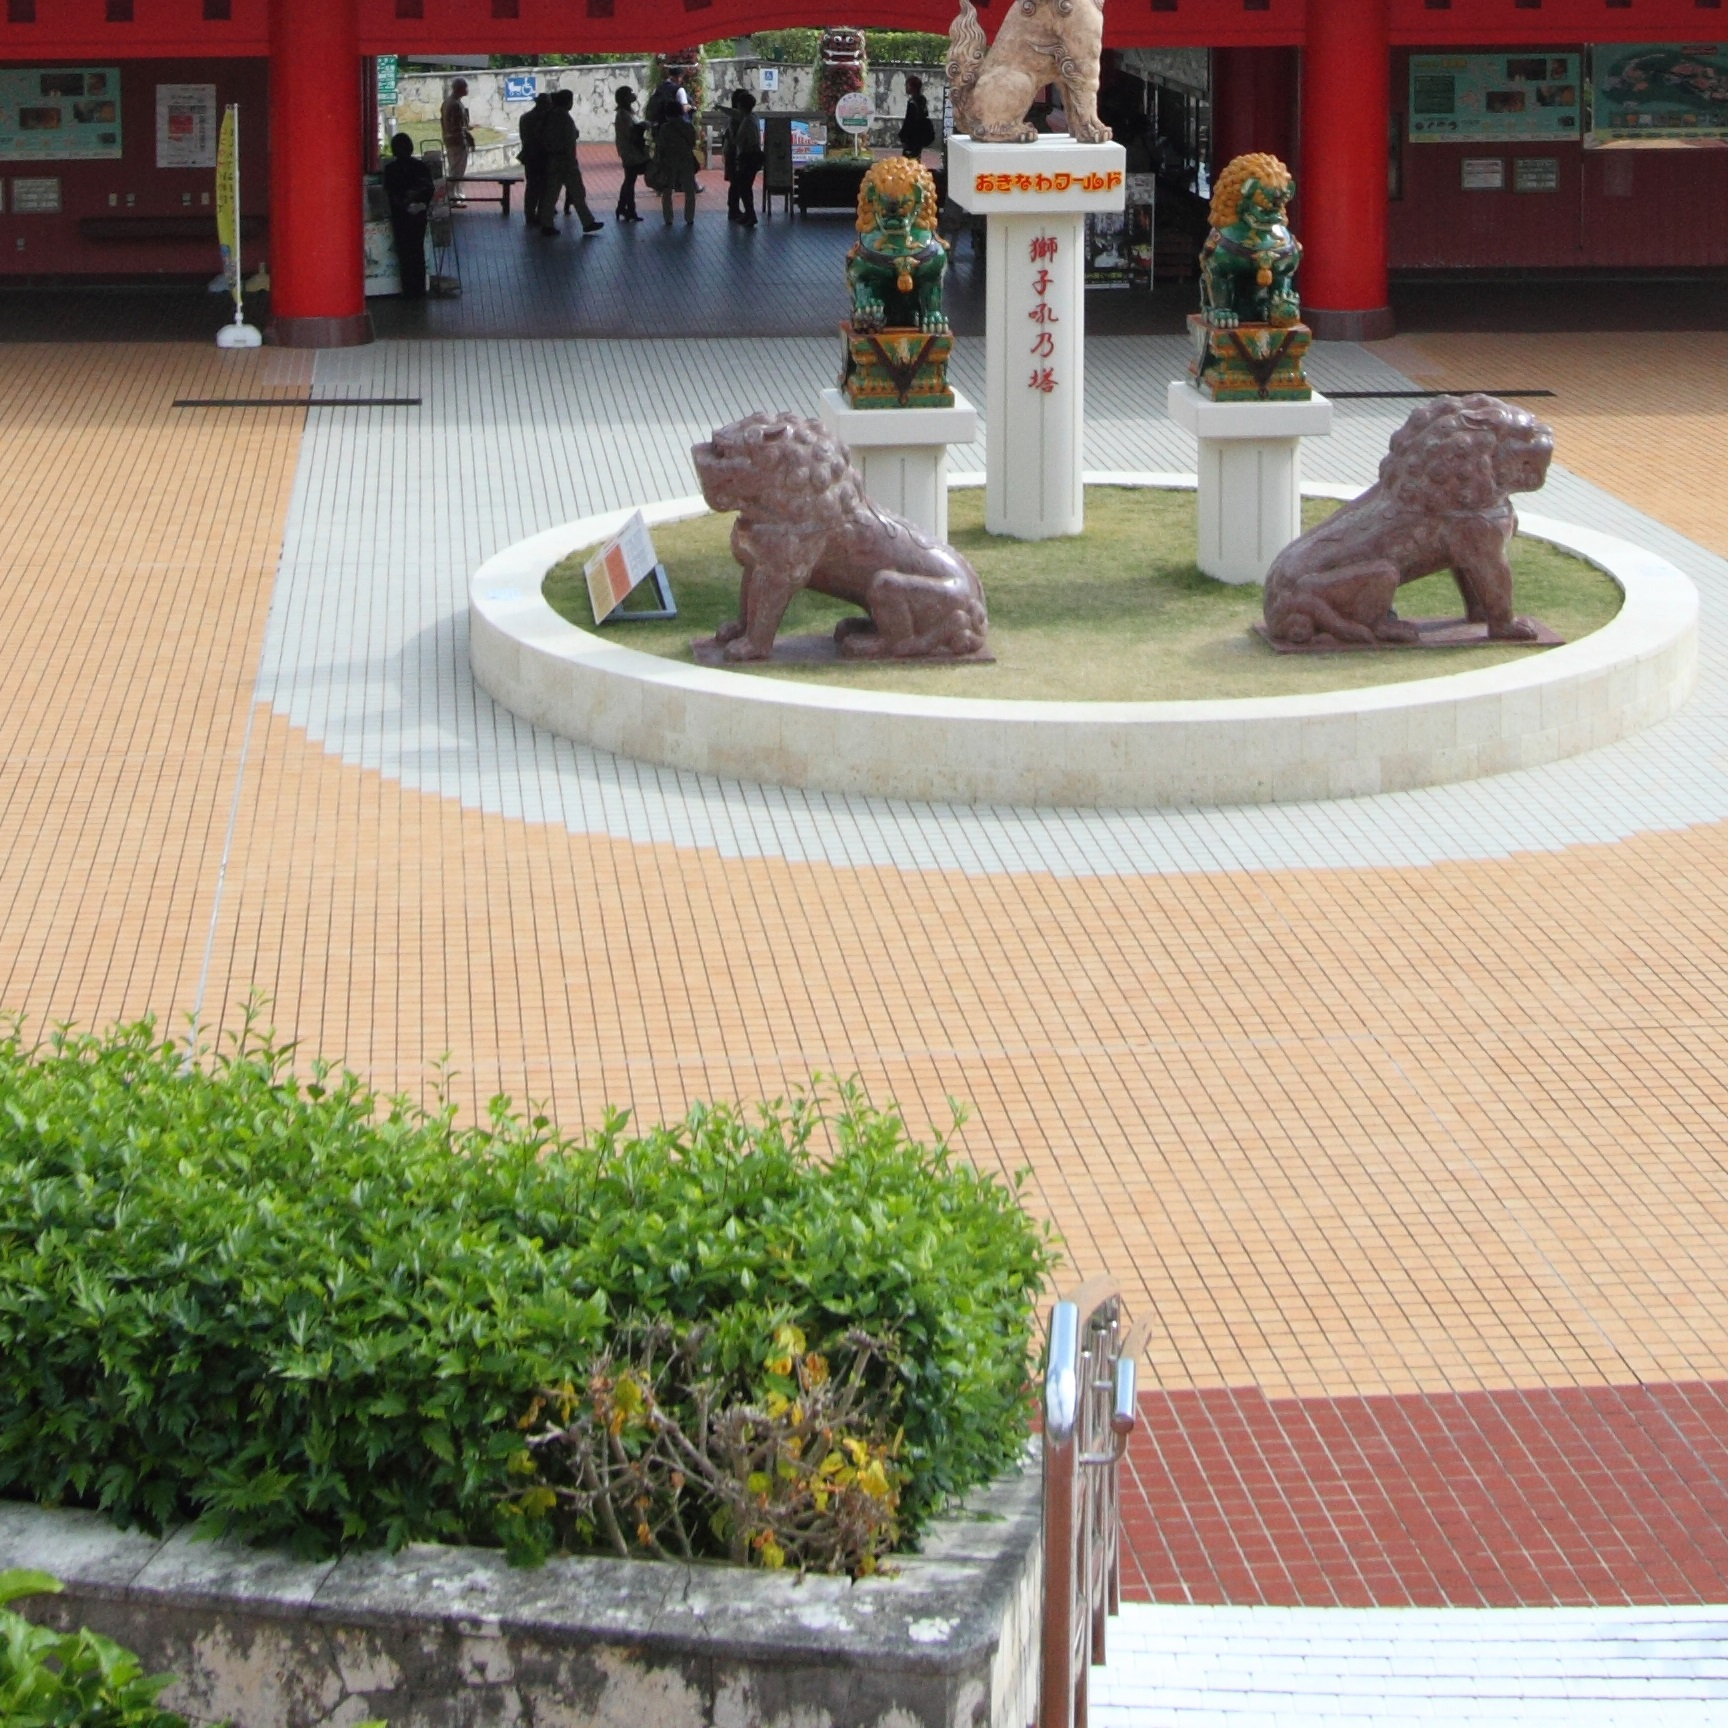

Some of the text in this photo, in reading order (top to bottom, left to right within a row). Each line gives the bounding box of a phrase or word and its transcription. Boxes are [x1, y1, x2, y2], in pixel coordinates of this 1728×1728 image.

[975, 171, 1122, 193] おきなわワールド
[1028, 237, 1059, 392] 獅子吼乃塔
